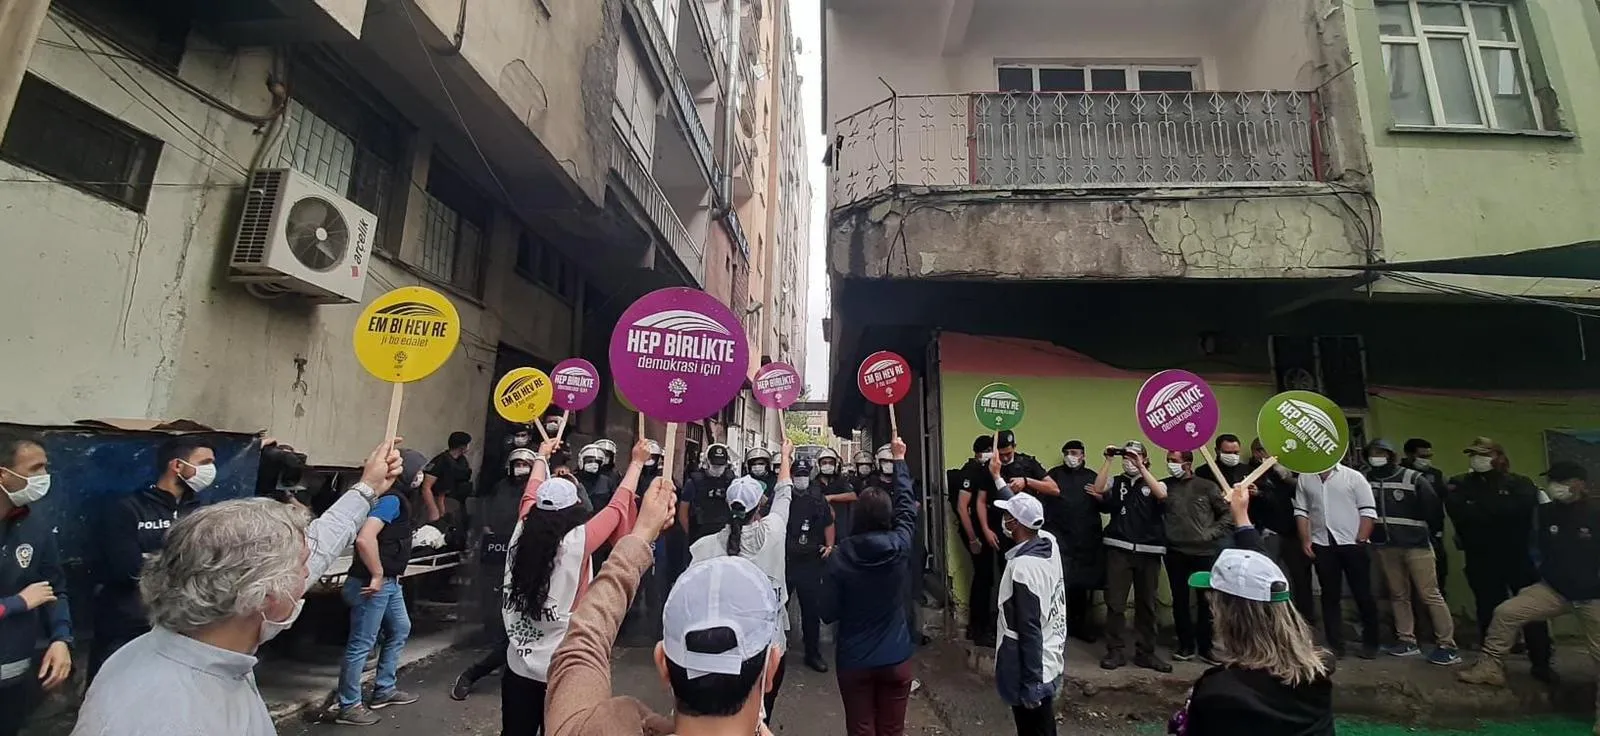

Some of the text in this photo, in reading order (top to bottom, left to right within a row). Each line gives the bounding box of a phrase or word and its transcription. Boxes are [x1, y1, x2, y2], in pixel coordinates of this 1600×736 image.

[354, 218, 368, 265] arçelik
[368, 316, 448, 337] EM BI HEV RE
[389, 335, 400, 345] bo
[627, 329, 735, 363] HEP BİRLİKTE
[638, 355, 721, 376] demokrasi için
[501, 395, 514, 407] EM
[520, 383, 535, 397] HEV
[533, 378, 545, 389] RE
[1146, 384, 1204, 429] HEP BİRLİKTE
[1161, 407, 1193, 432] demokrasi
[1276, 400, 1338, 456] HEP BİRLİKTE
[137, 519, 171, 530] POLİS
